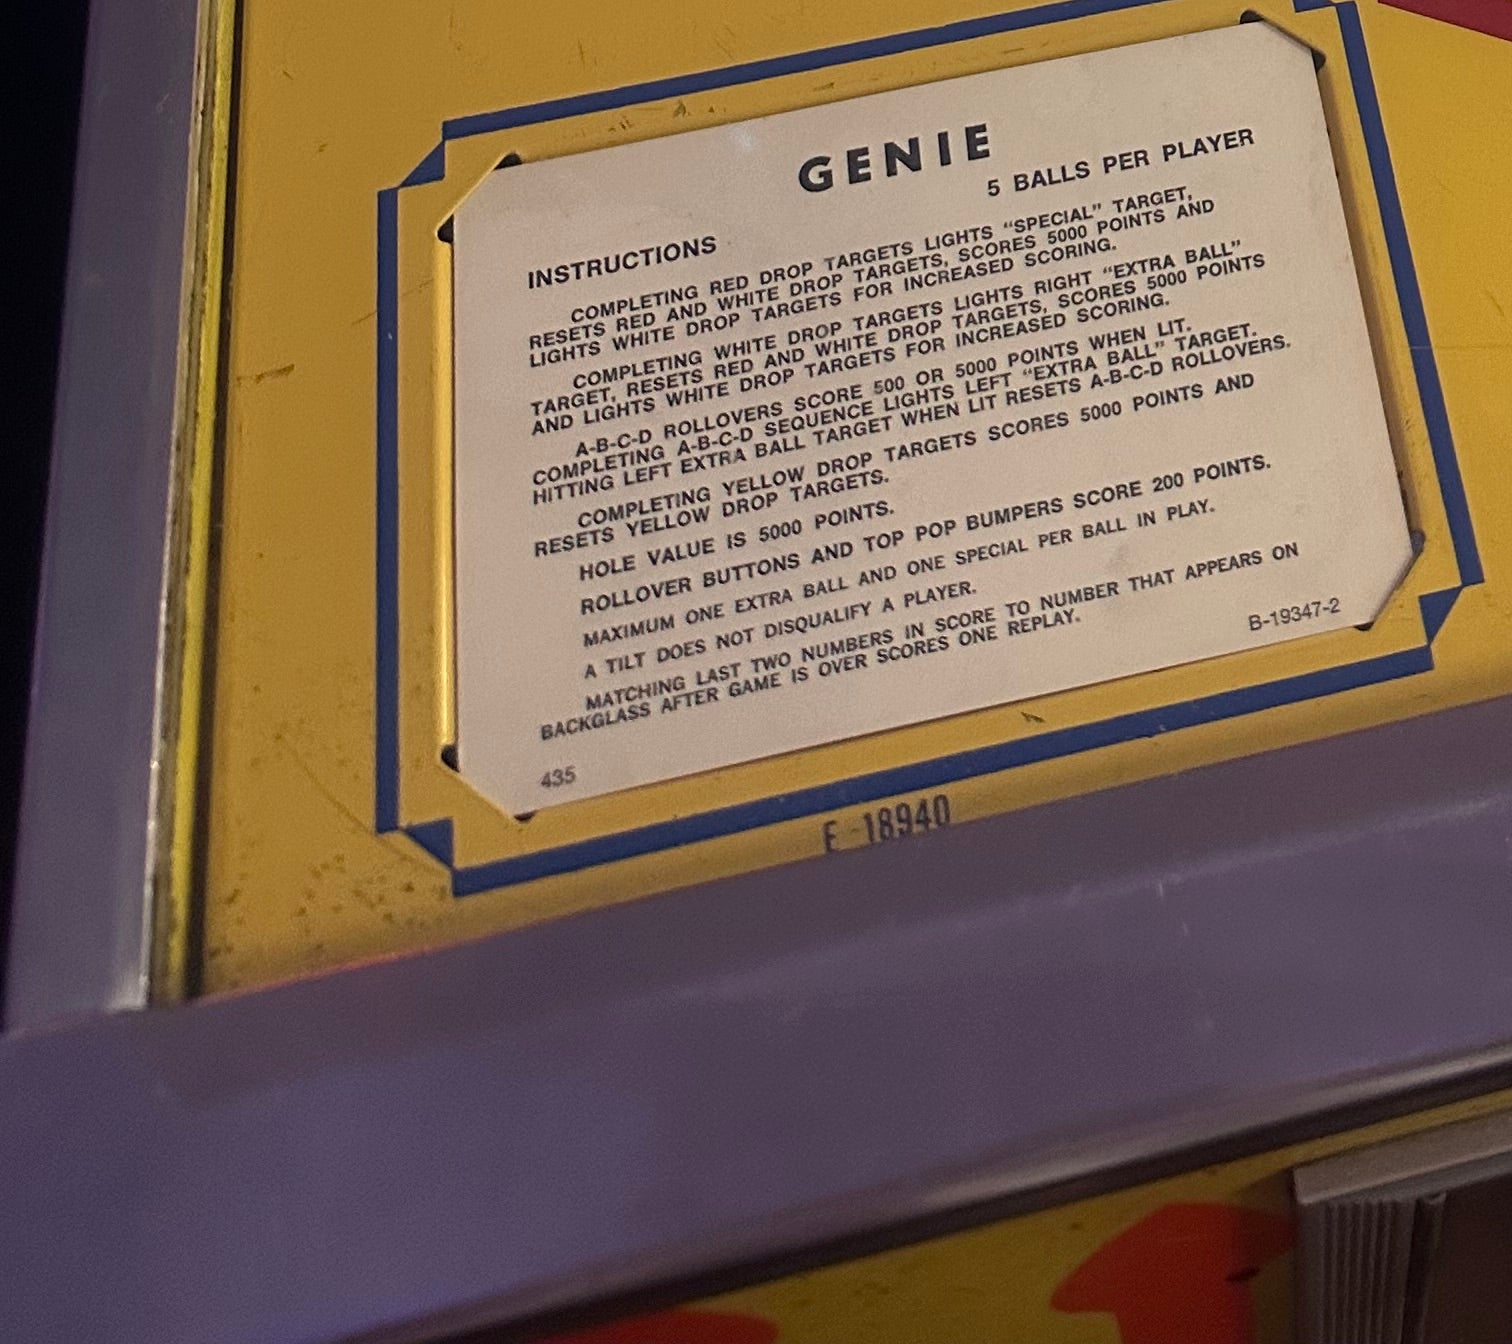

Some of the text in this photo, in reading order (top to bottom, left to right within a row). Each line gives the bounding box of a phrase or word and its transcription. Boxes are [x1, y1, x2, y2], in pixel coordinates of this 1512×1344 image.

[797, 124, 991, 193] GENIE
[986, 127, 1255, 197] 5 BALLS PER PLAYER
[527, 234, 717, 290] INSTRUCTIONS
[528, 198, 1215, 351] RESETS RED AND WHITE DROP TARGETS, SCORES 5000 POINTS AND
[578, 499, 895, 582] HOLE VALUE IS 5000 POINTS.
[583, 579, 977, 680] A TILT DOES NOT DISQUALIFY A PLAYER.
[1246, 596, 1341, 632] B-19347-2
[539, 606, 1081, 742] BACKGLASS AFTER GAME IS OVER SCORES ONE REPLAY.
[539, 765, 576, 788] 435
